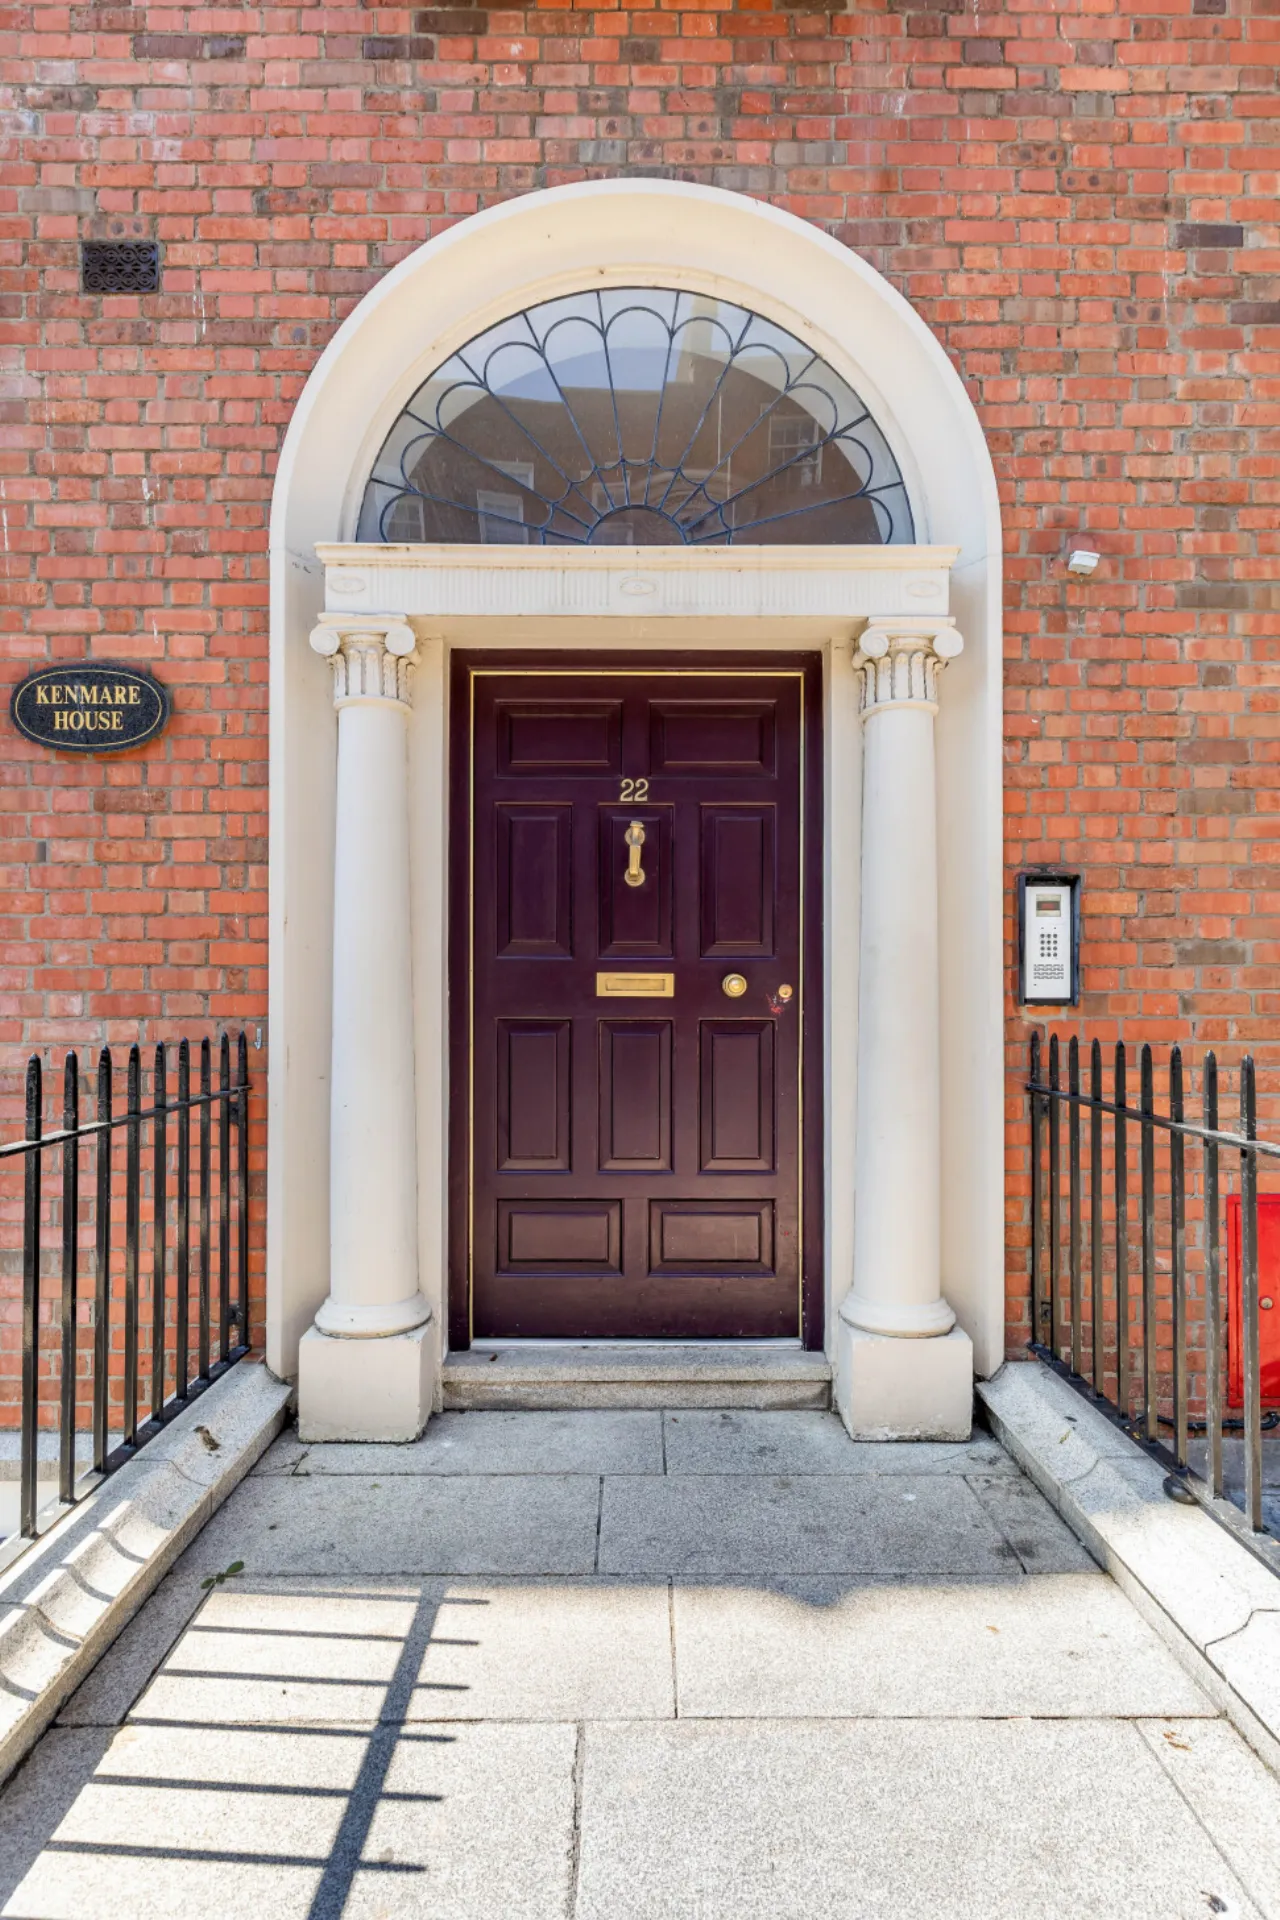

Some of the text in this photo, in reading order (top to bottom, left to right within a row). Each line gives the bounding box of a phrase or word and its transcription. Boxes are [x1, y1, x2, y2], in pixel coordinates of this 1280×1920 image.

[36, 684, 141, 705] KENMARE
[53, 710, 124, 731] HOUSE
[620, 778, 649, 802] 22
